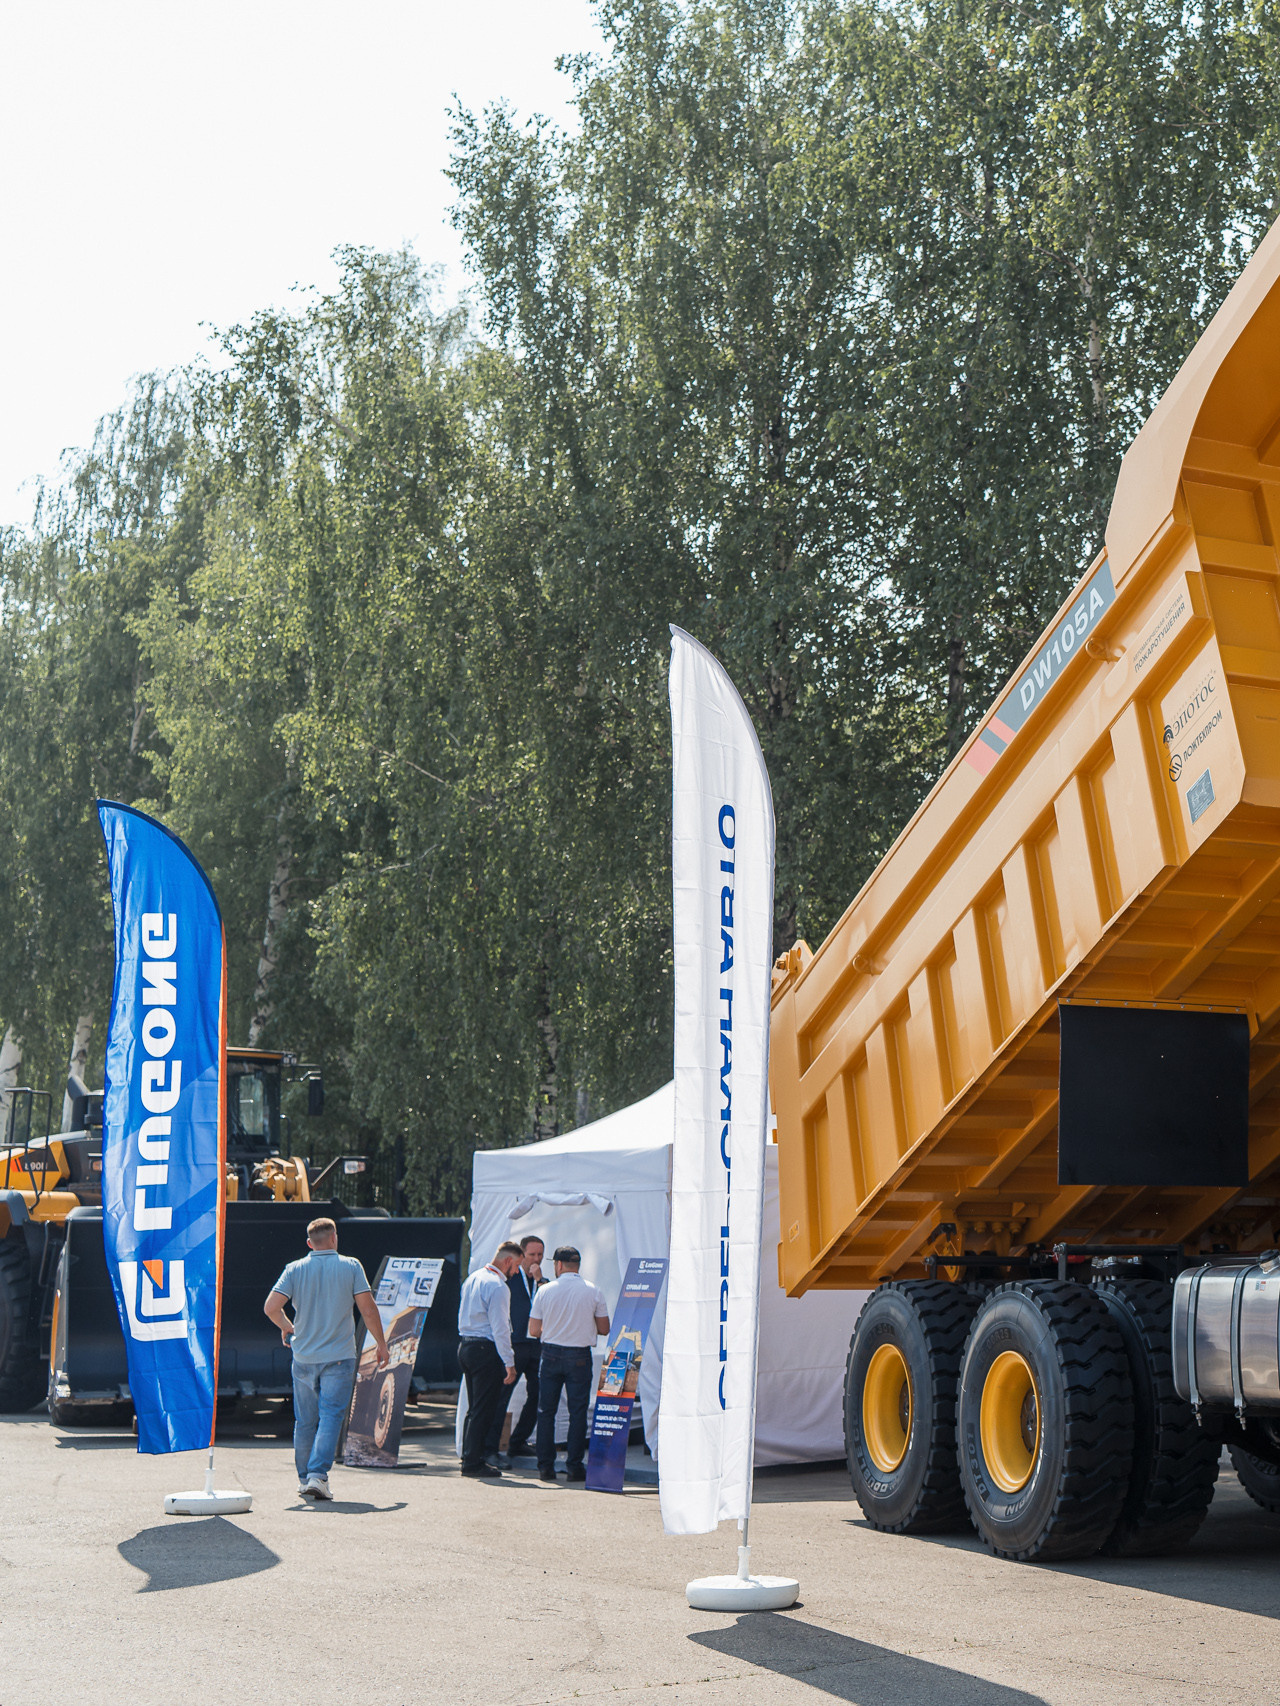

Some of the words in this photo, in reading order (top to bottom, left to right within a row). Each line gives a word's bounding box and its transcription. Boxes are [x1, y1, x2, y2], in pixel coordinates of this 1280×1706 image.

[1019, 587, 1104, 712] DW105A
[1134, 602, 1186, 673] ПОЖАРОТУШЕНИЯ
[1172, 676, 1217, 738] ЭПОТОС
[1183, 709, 1223, 762] ПОЖТЕХПРОМ
